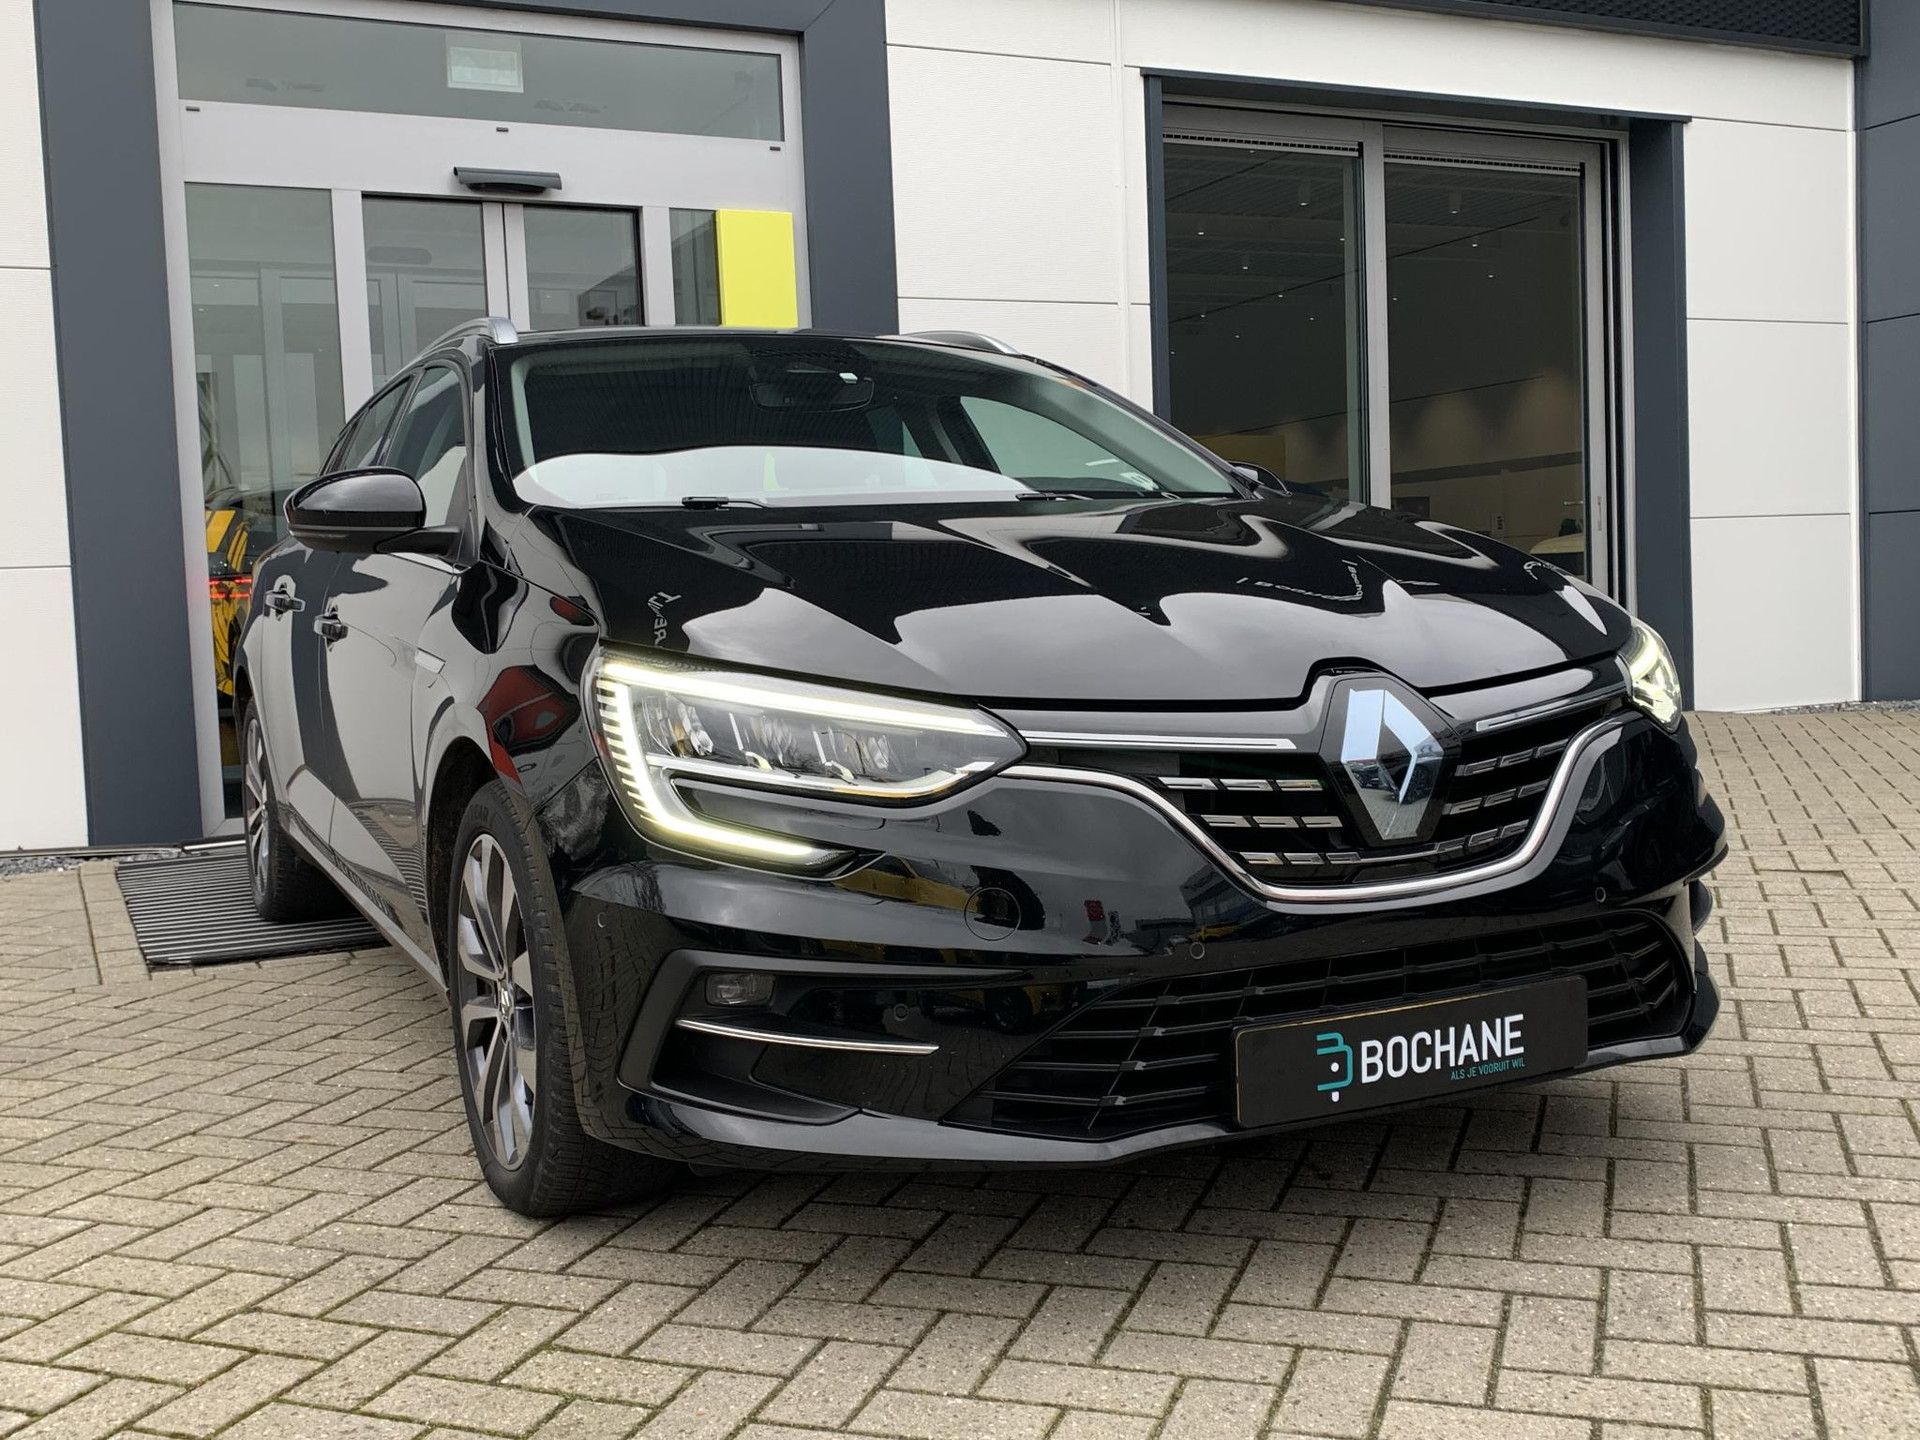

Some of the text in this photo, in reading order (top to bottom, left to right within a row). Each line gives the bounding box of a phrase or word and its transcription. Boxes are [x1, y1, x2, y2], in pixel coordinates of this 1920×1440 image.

[1361, 1013, 1525, 1084] BOCHANE
[1450, 1057, 1526, 1081] ALS JE VOORUIT WIL
